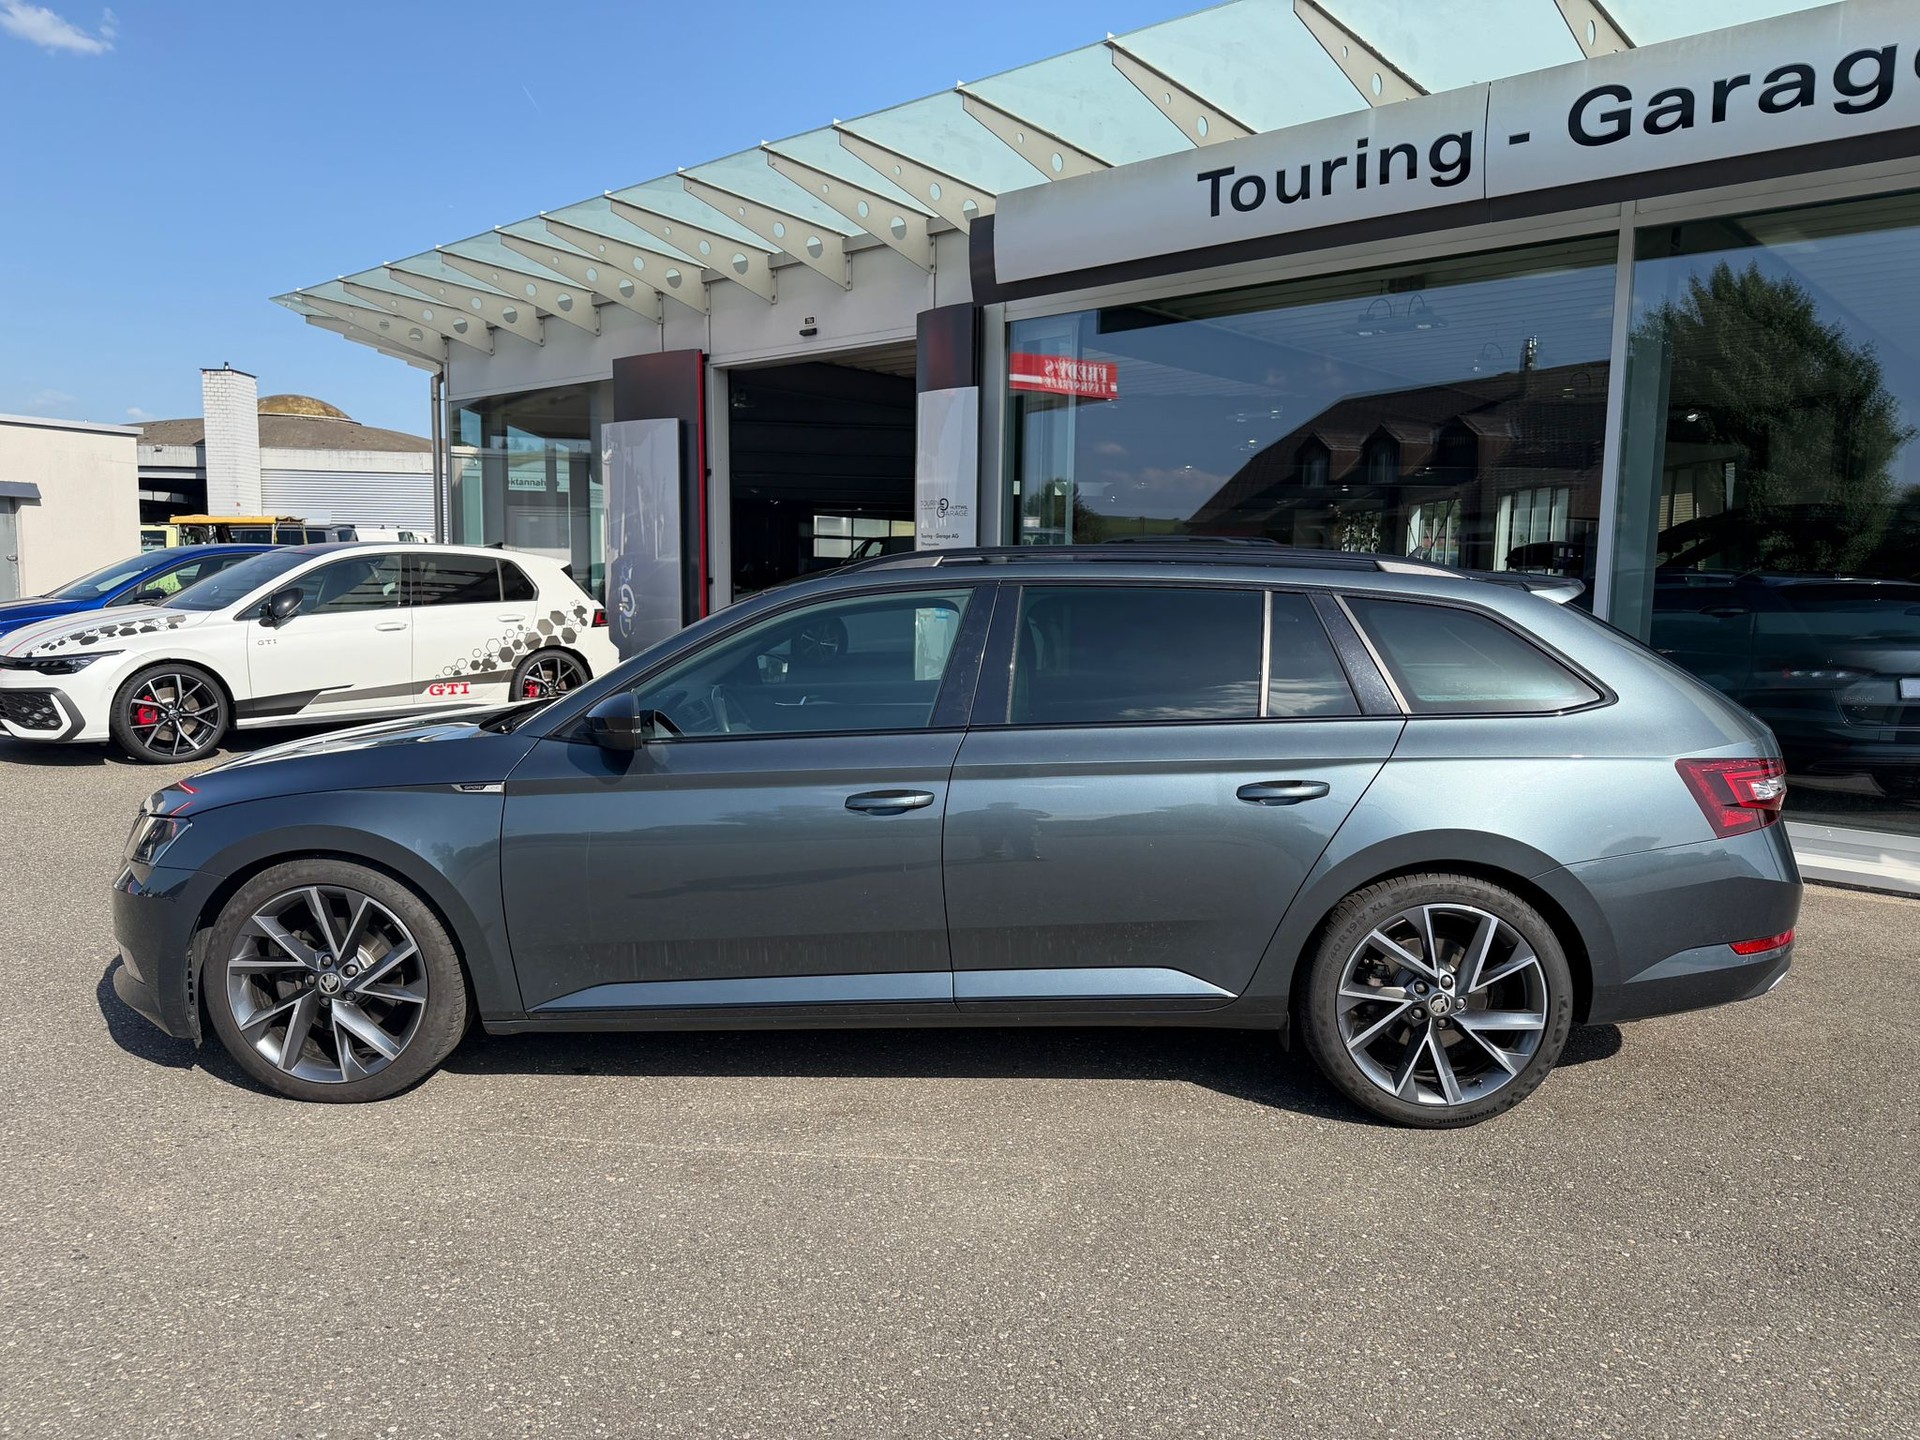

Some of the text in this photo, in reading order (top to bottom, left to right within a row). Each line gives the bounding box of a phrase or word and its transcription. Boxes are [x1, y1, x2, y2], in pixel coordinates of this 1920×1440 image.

[1197, 42, 1920, 217] Touring - Garag
[429, 682, 470, 696] GTI
